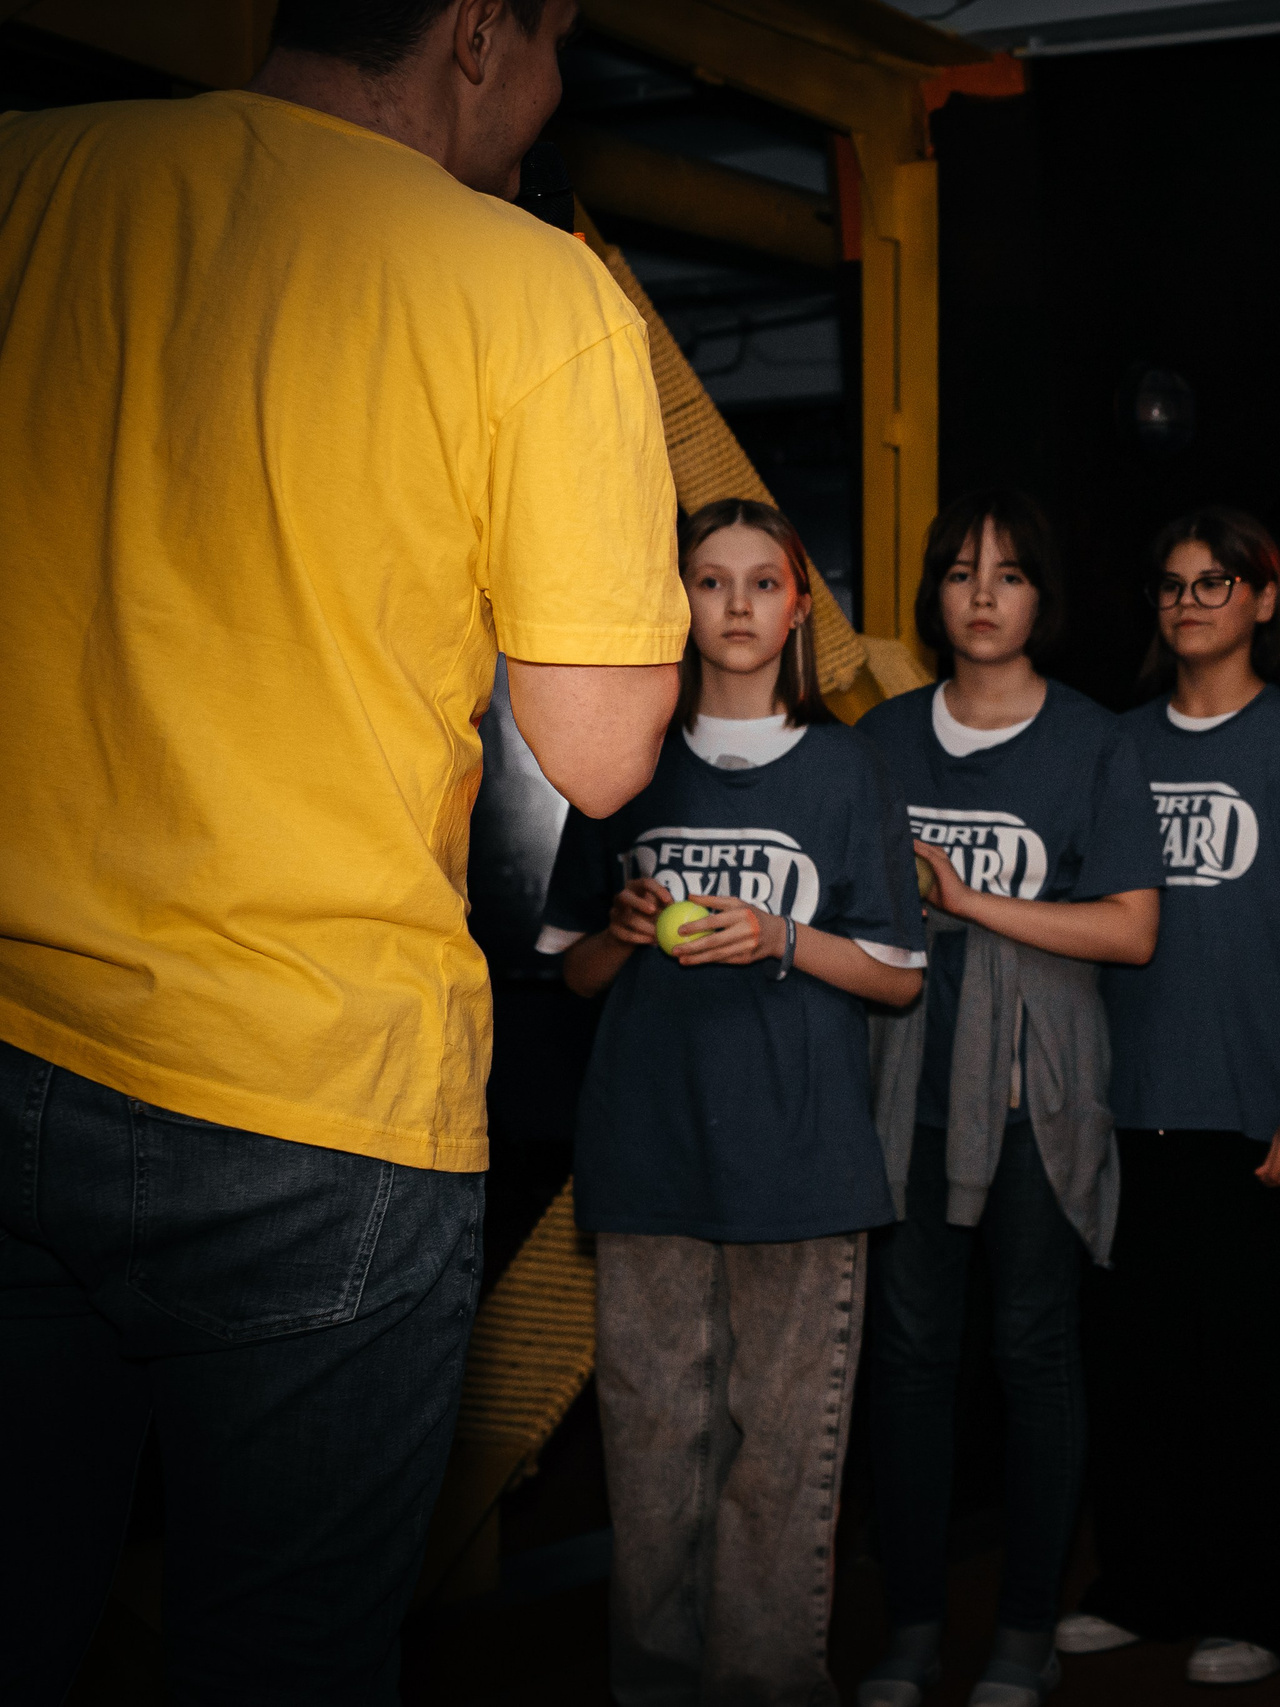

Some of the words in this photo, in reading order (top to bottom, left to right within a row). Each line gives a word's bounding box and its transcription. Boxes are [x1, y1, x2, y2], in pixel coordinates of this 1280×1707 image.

[660, 842, 763, 868] FORT
[943, 826, 1048, 900] ARD
[1159, 794, 1259, 880] ARD
